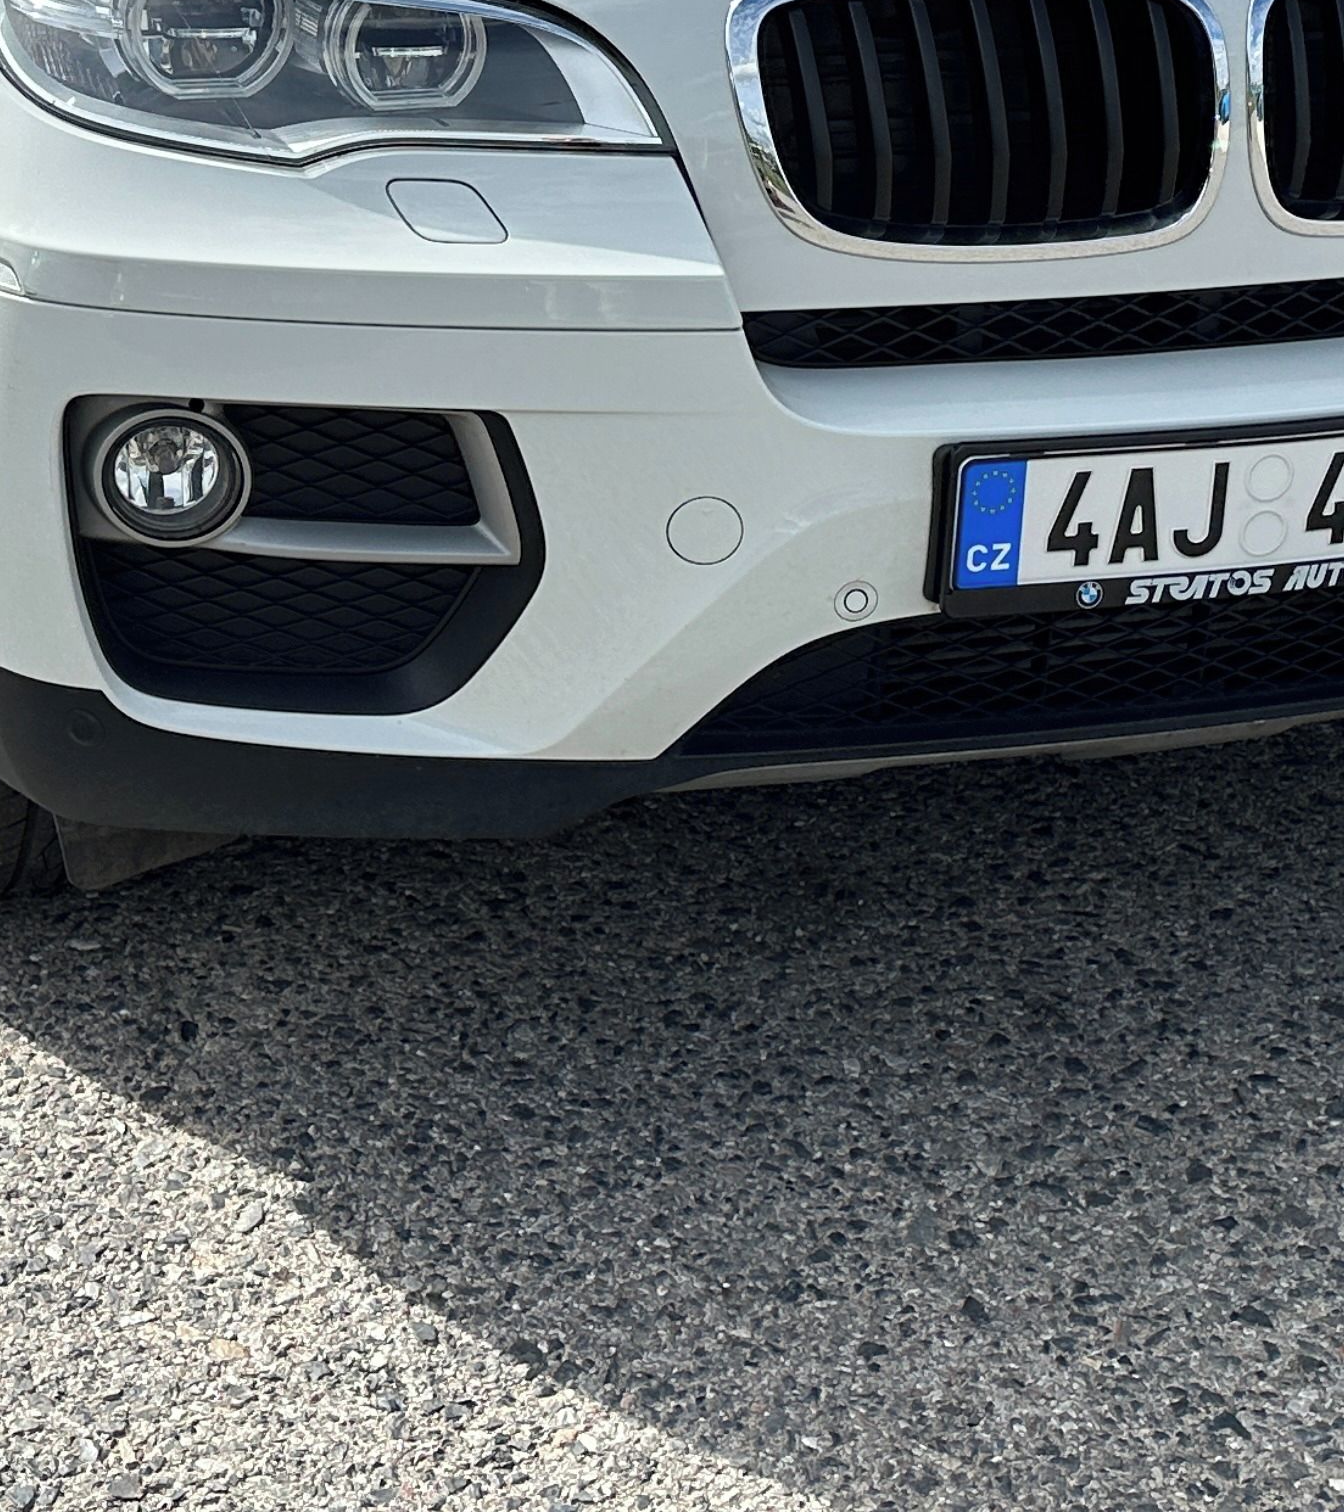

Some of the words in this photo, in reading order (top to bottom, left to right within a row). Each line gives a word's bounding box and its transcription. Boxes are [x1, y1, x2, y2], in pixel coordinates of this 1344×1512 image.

[965, 541, 1011, 573] CZ
[1045, 461, 1231, 567] 4AJ
[1125, 568, 1276, 606] STRATOS
